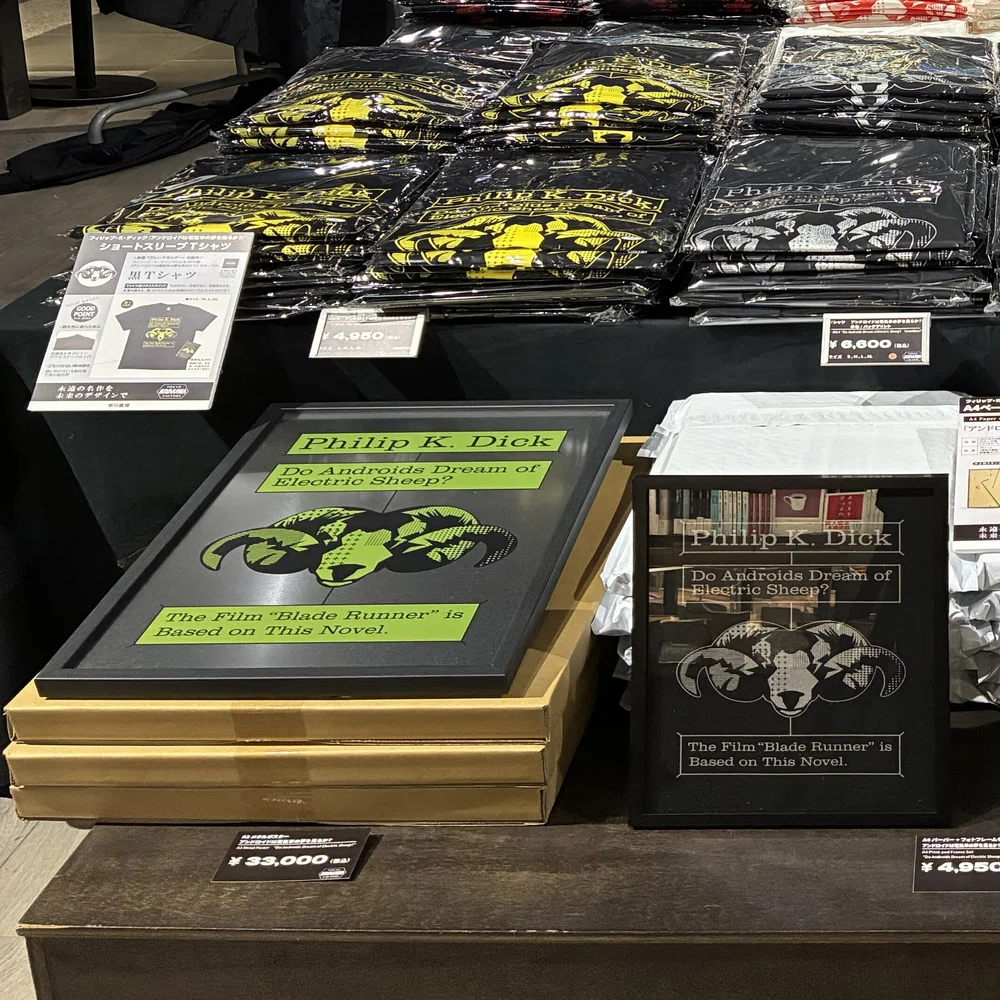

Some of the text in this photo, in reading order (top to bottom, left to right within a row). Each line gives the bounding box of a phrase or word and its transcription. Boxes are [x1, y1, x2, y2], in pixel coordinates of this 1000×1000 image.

[299, 435, 553, 451] Philip K. Dick
[280, 464, 540, 476] Do Androids Dream of
[272, 476, 453, 486] Electric Sheep?
[691, 530, 892, 549] Philip K. Dick
[692, 570, 892, 581] Do Androids Dream of
[692, 584, 829, 597] Electric Sheep?
[166, 610, 463, 622] The Film “Blade Runner” is
[153, 625, 388, 636] Based on This Novel.
[688, 742, 716, 751] The
[721, 742, 755, 751] Film
[811, 742, 874, 751] Runner”
[880, 742, 892, 751] is
[689, 757, 734, 766] Based
[762, 757, 795, 766] This
[801, 757, 848, 766] Novel.
